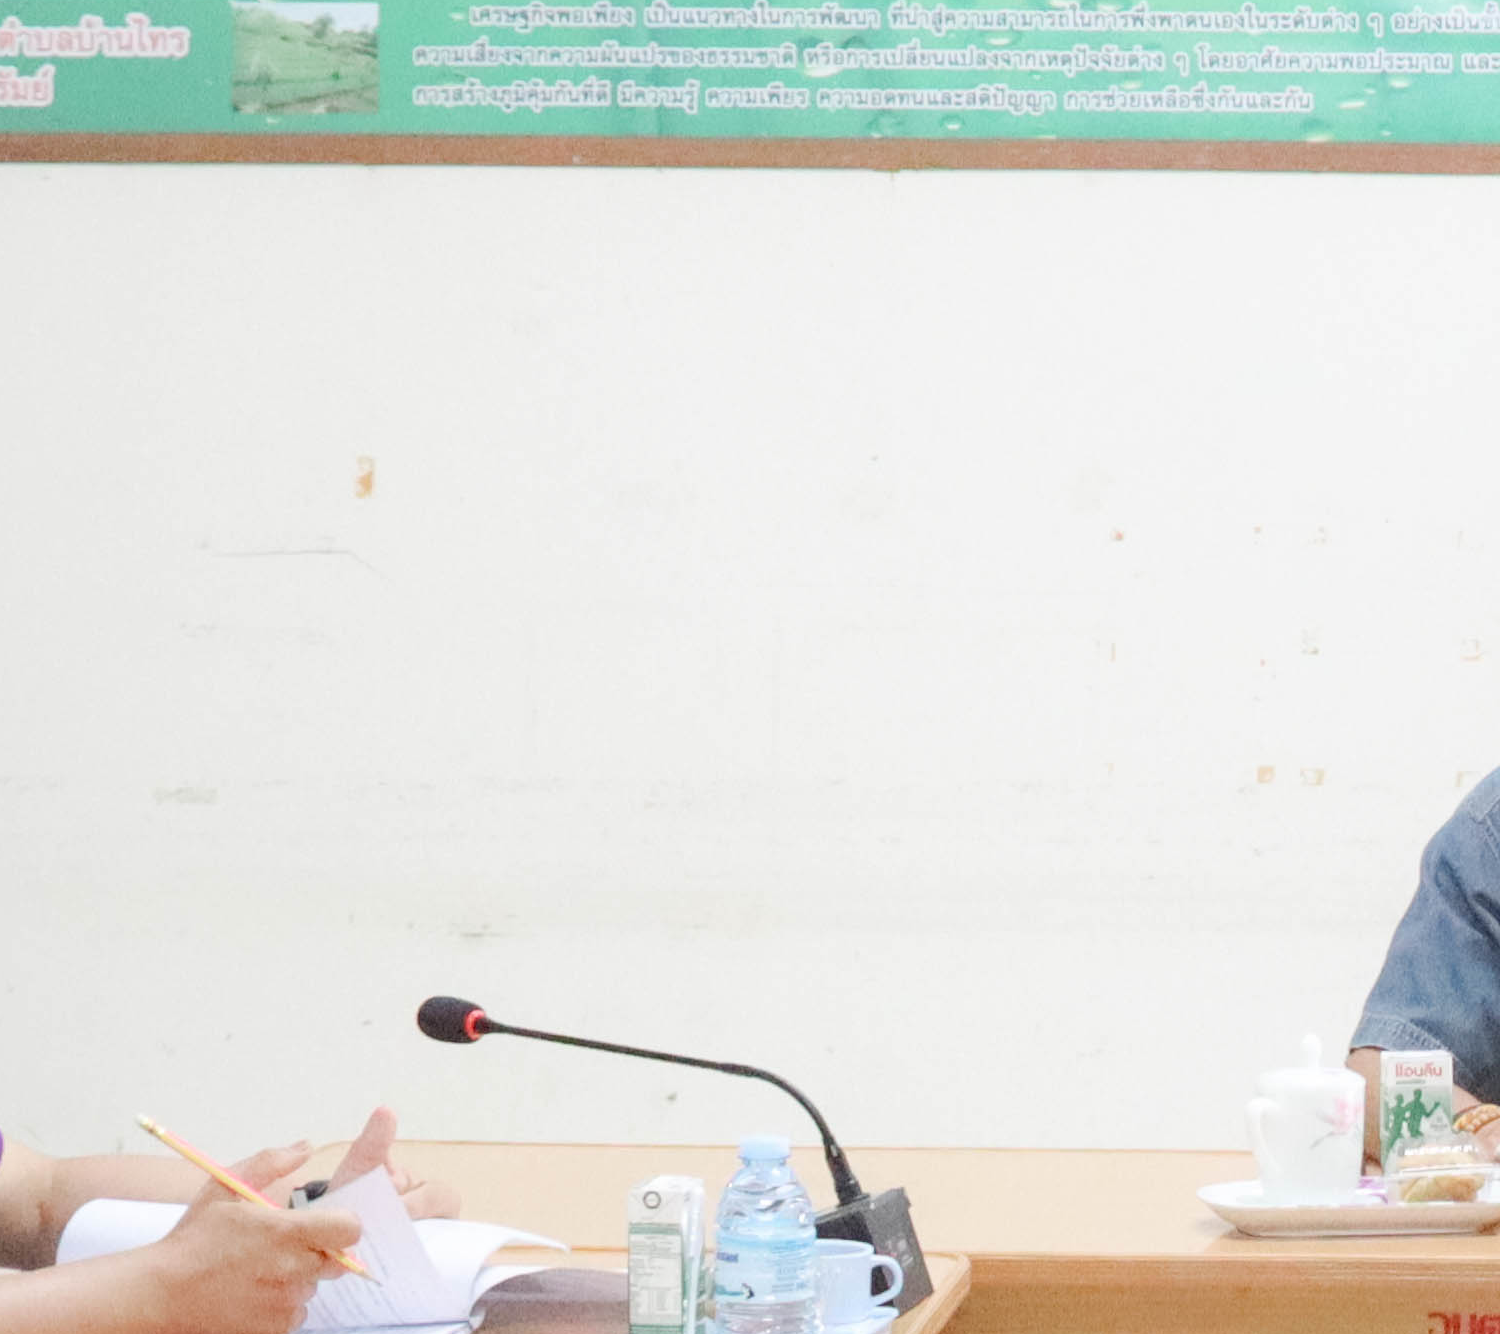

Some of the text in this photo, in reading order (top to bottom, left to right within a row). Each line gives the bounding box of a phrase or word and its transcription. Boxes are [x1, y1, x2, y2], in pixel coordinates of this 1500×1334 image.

[470, 2, 636, 33] เศรษฐกิจพอเพียง
[645, 2, 881, 30] เป็นแนวทางในการพัฒนา
[412, 77, 611, 113] การสร้างภูมิคุ้มกันที่ดี
[617, 79, 700, 114] มีความรู้
[706, 81, 809, 108] ความเพียร
